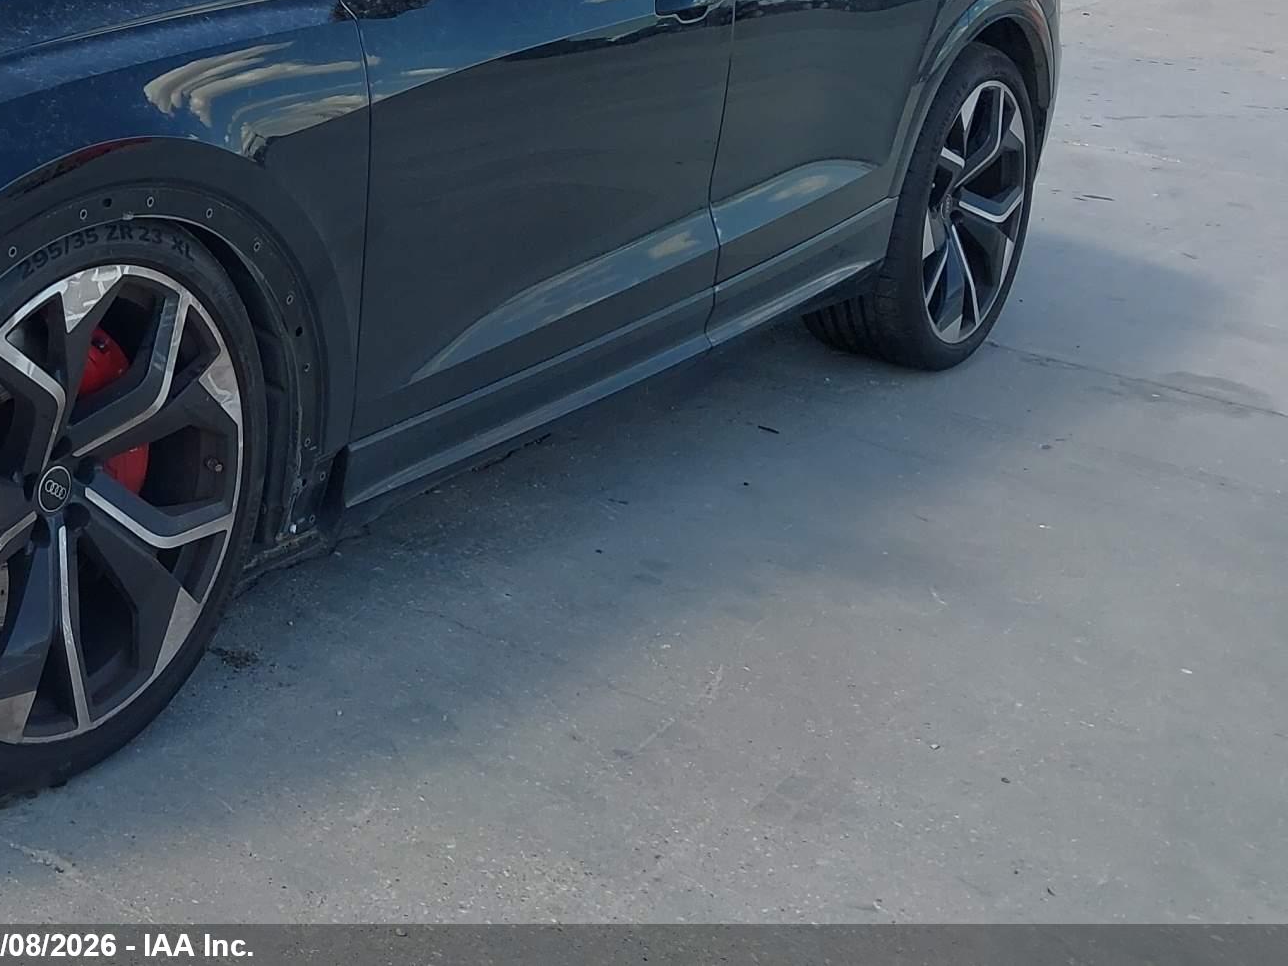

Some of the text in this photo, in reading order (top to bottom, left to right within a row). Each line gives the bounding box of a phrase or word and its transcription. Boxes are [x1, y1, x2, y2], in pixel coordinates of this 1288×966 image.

[20, 227, 100, 281] 295/35
[104, 225, 134, 241] ZR
[138, 226, 163, 245] 23
